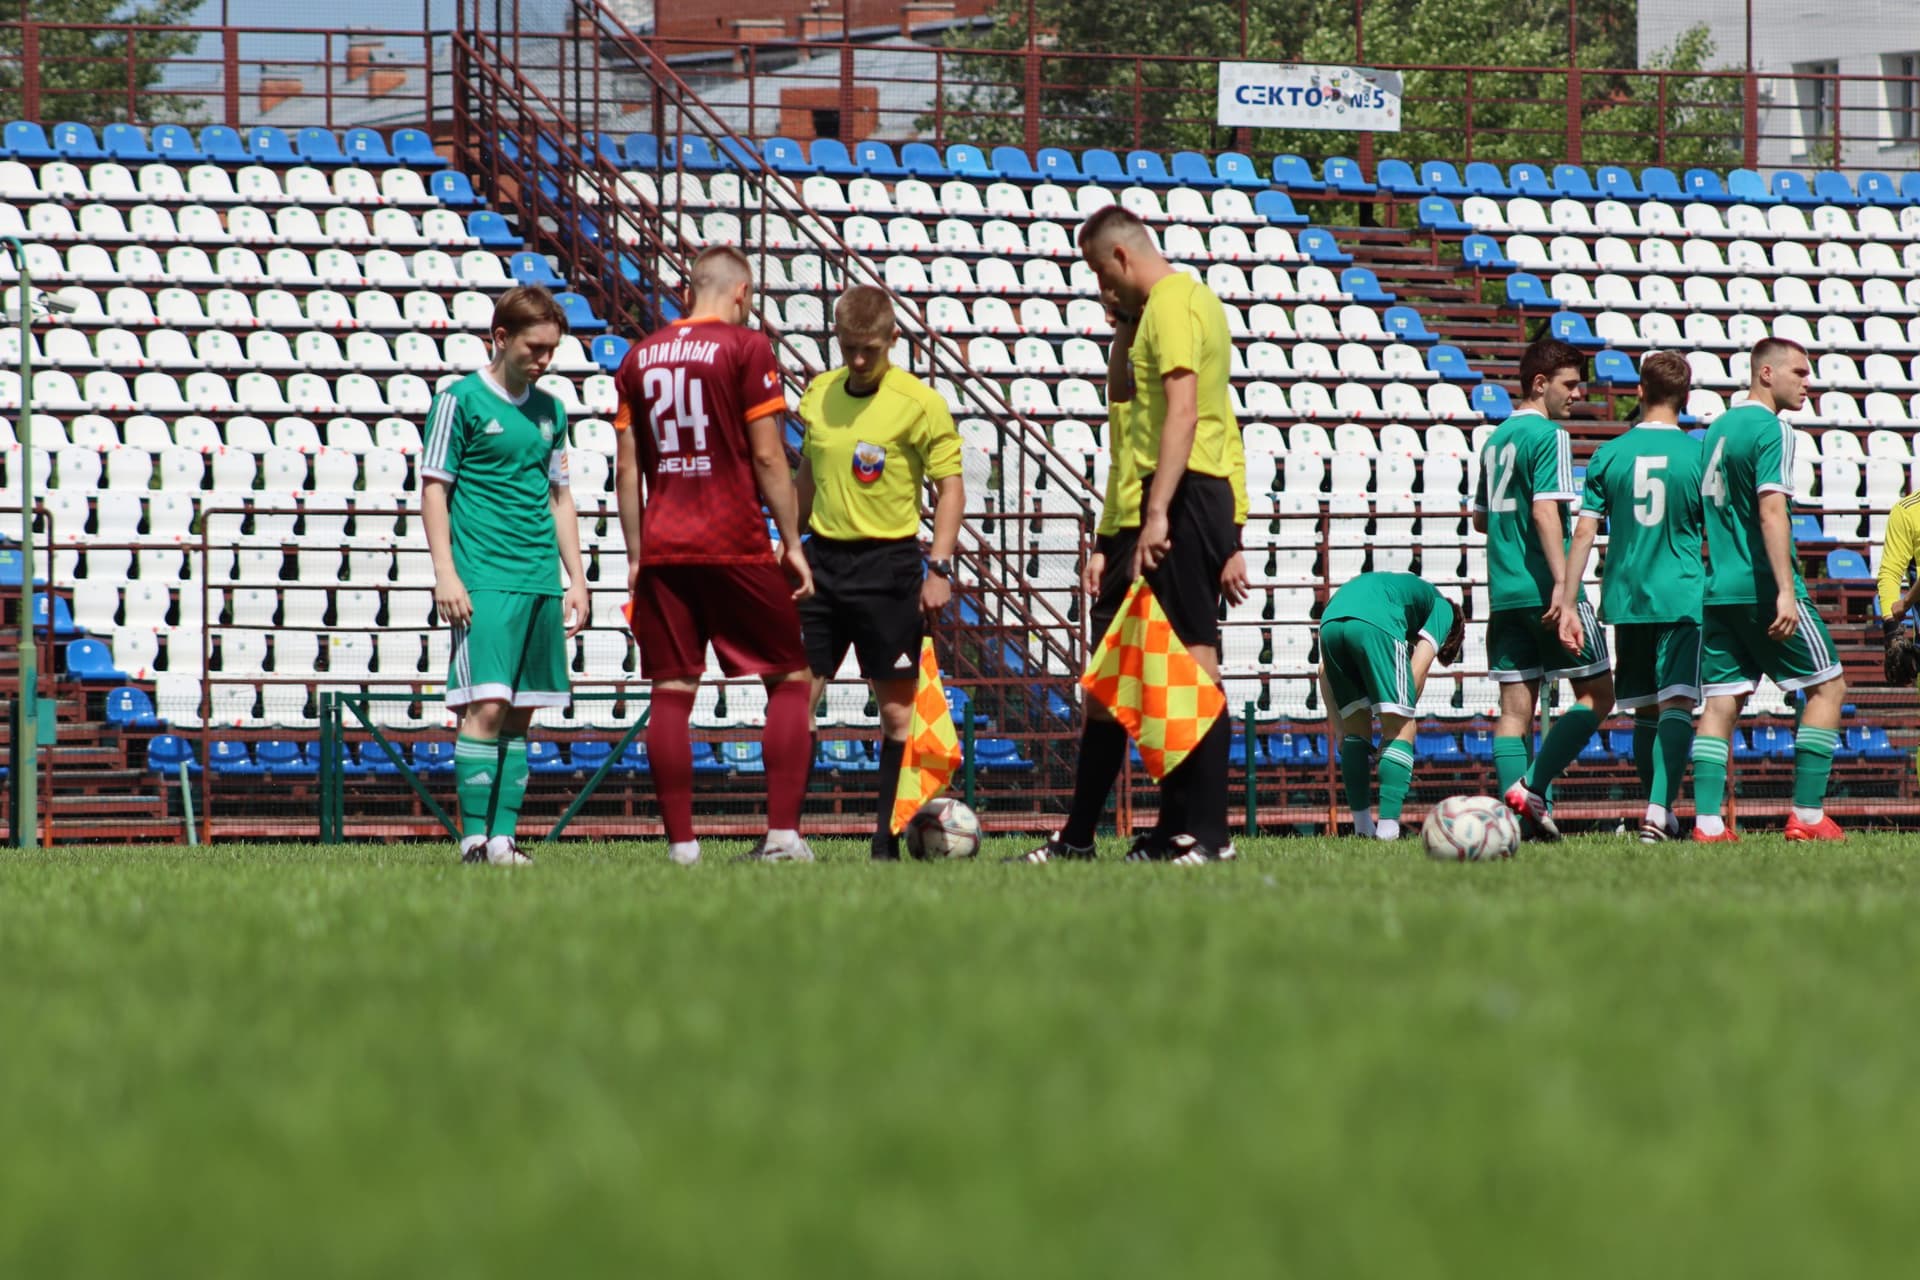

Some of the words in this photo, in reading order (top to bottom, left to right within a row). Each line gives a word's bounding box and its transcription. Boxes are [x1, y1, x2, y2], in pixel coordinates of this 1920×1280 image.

[1235, 85, 1340, 108] СЕКТО
[638, 338, 720, 369] ОЛИЙНЫК
[643, 367, 709, 453] 24
[1483, 443, 1517, 513] 12
[1633, 456, 1668, 527] 5
